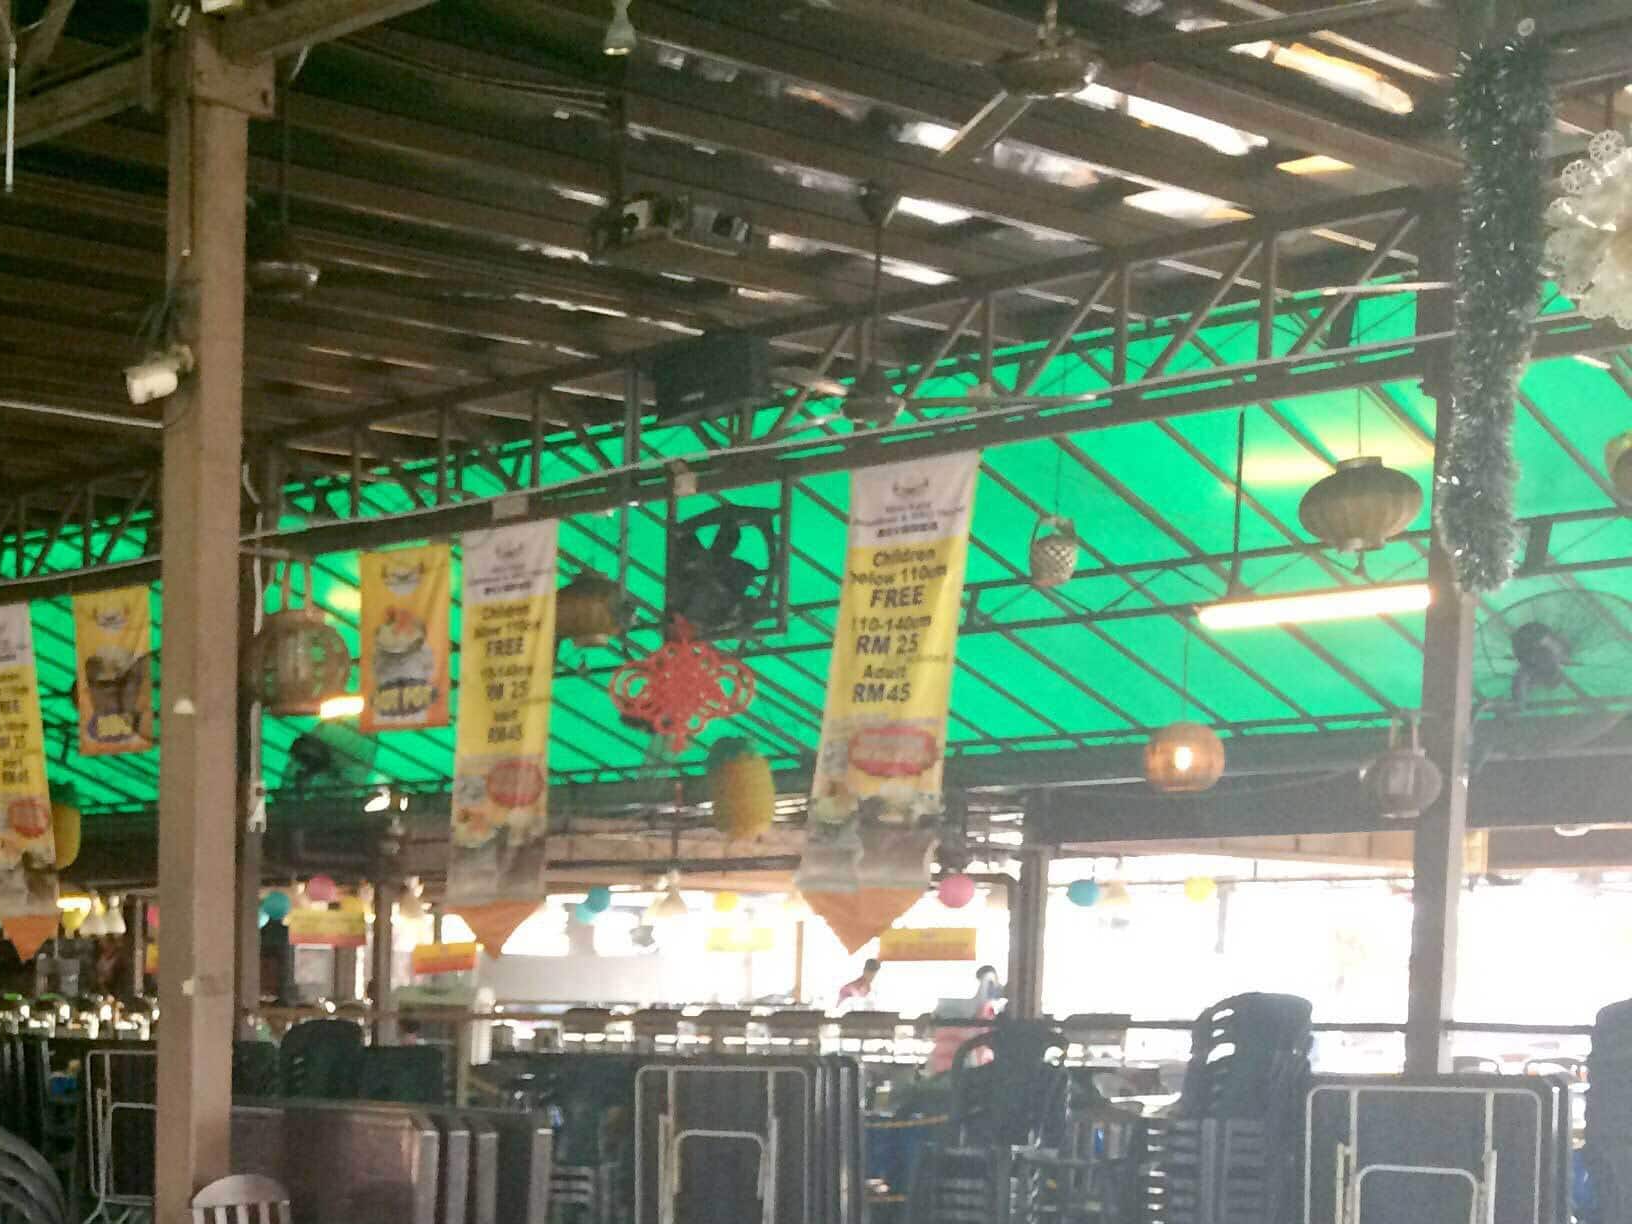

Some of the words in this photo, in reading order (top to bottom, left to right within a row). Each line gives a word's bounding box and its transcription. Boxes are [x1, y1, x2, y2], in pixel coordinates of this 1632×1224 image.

[872, 548, 936, 568] Children
[870, 584, 925, 609] FREE
[856, 633, 891, 656] RM
[896, 631, 920, 656] 25
